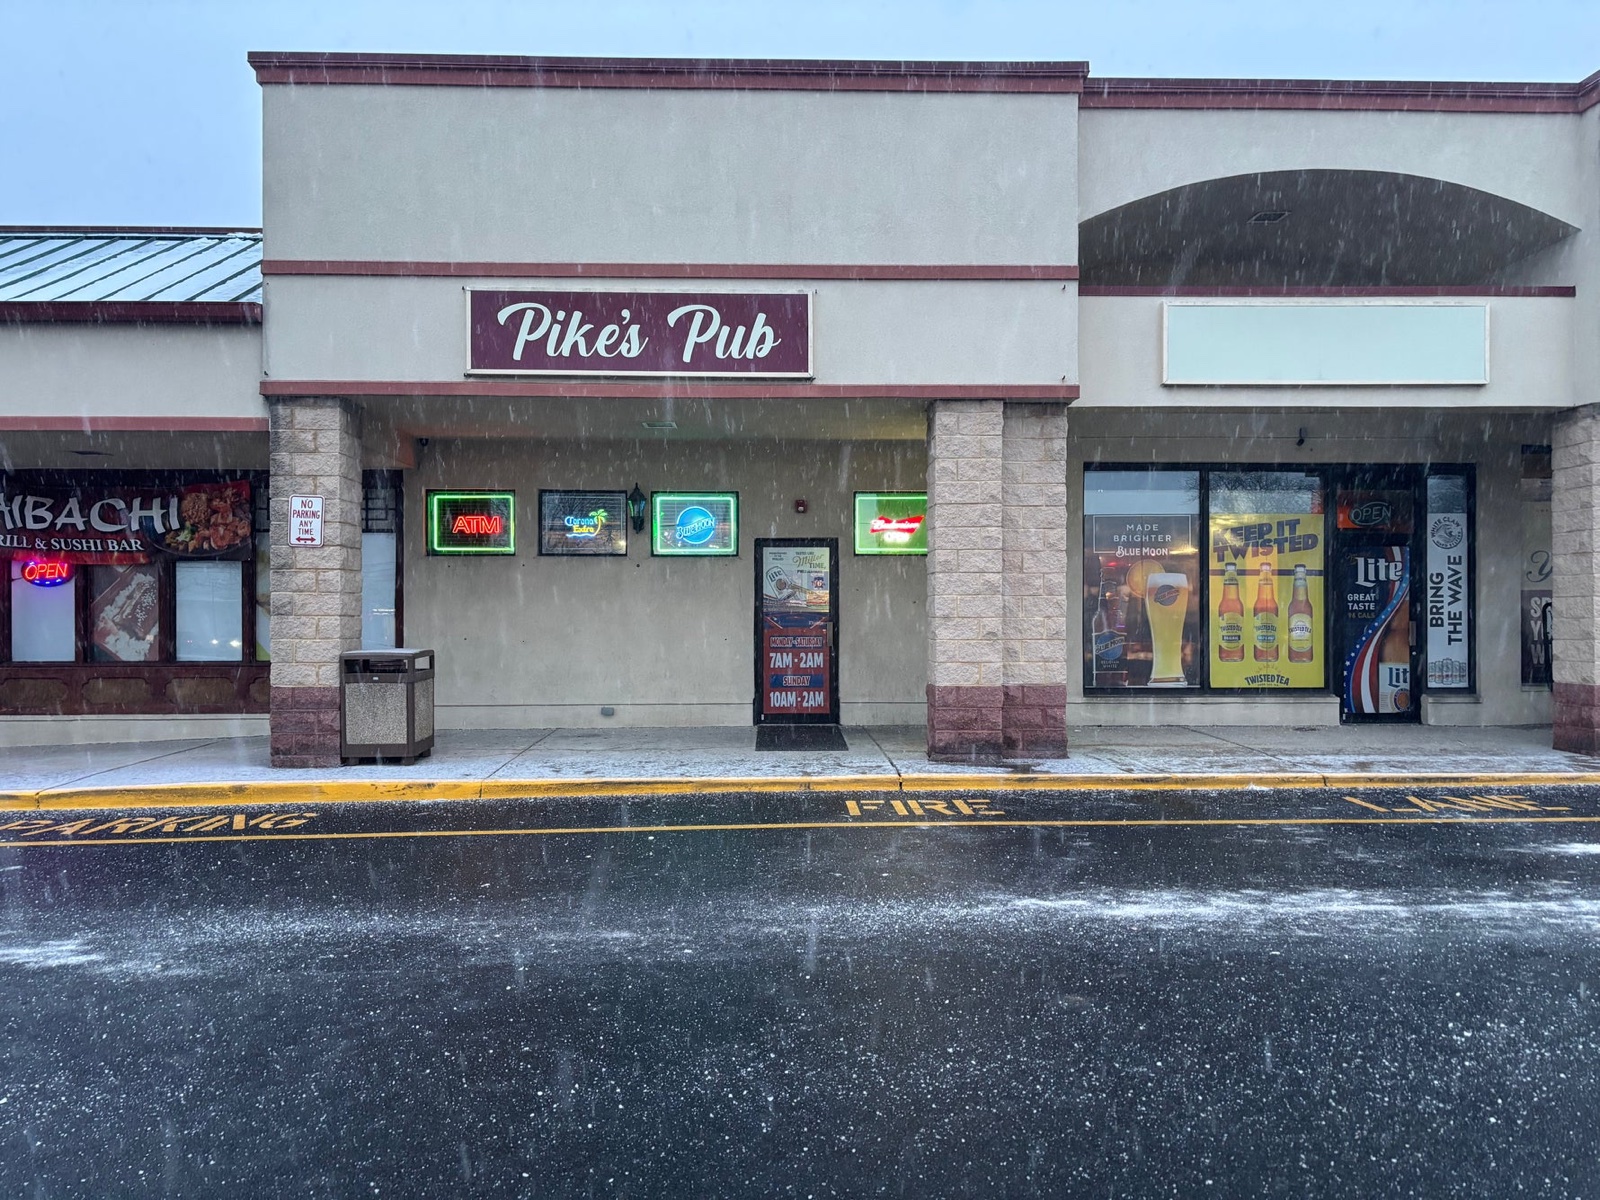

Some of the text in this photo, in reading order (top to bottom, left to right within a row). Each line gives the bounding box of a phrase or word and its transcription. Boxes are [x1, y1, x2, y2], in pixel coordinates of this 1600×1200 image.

[497, 302, 782, 363] Pike's Pub
[301, 500, 313, 509] NO
[293, 510, 320, 519] PARKING
[1351, 504, 1392, 522] OPEN
[299, 520, 313, 528] ANY
[452, 515, 500, 534] ATM
[564, 516, 594, 526] Corona
[573, 525, 595, 533] Extra
[1212, 518, 1301, 547] KEEP IT
[35, 537, 48, 550] &
[51, 538, 103, 551] SUSHI
[108, 539, 145, 551] BAR
[1113, 534, 1172, 542] BRIGHTER
[1116, 545, 1168, 558] BLUE MOON
[1212, 533, 1319, 563] TWISTED
[25, 563, 68, 580] OPEN
[1355, 556, 1402, 588] Lite
[1447, 555, 1462, 607] WAVE
[1347, 593, 1376, 601] GREAT
[1429, 572, 1444, 628] BRING
[1348, 602, 1375, 610] TASTE
[1357, 611, 1375, 619] CALS
[1447, 610, 1462, 646] THE
[769, 652, 792, 668] 7AM
[799, 652, 824, 668] 2AM
[783, 675, 811, 686] SUNDAY
[1244, 674, 1290, 686] TWISTED TEA
[769, 691, 796, 708] 10AM
[802, 691, 824, 708] 2AM
[845, 795, 1573, 816] FIRE LANE
